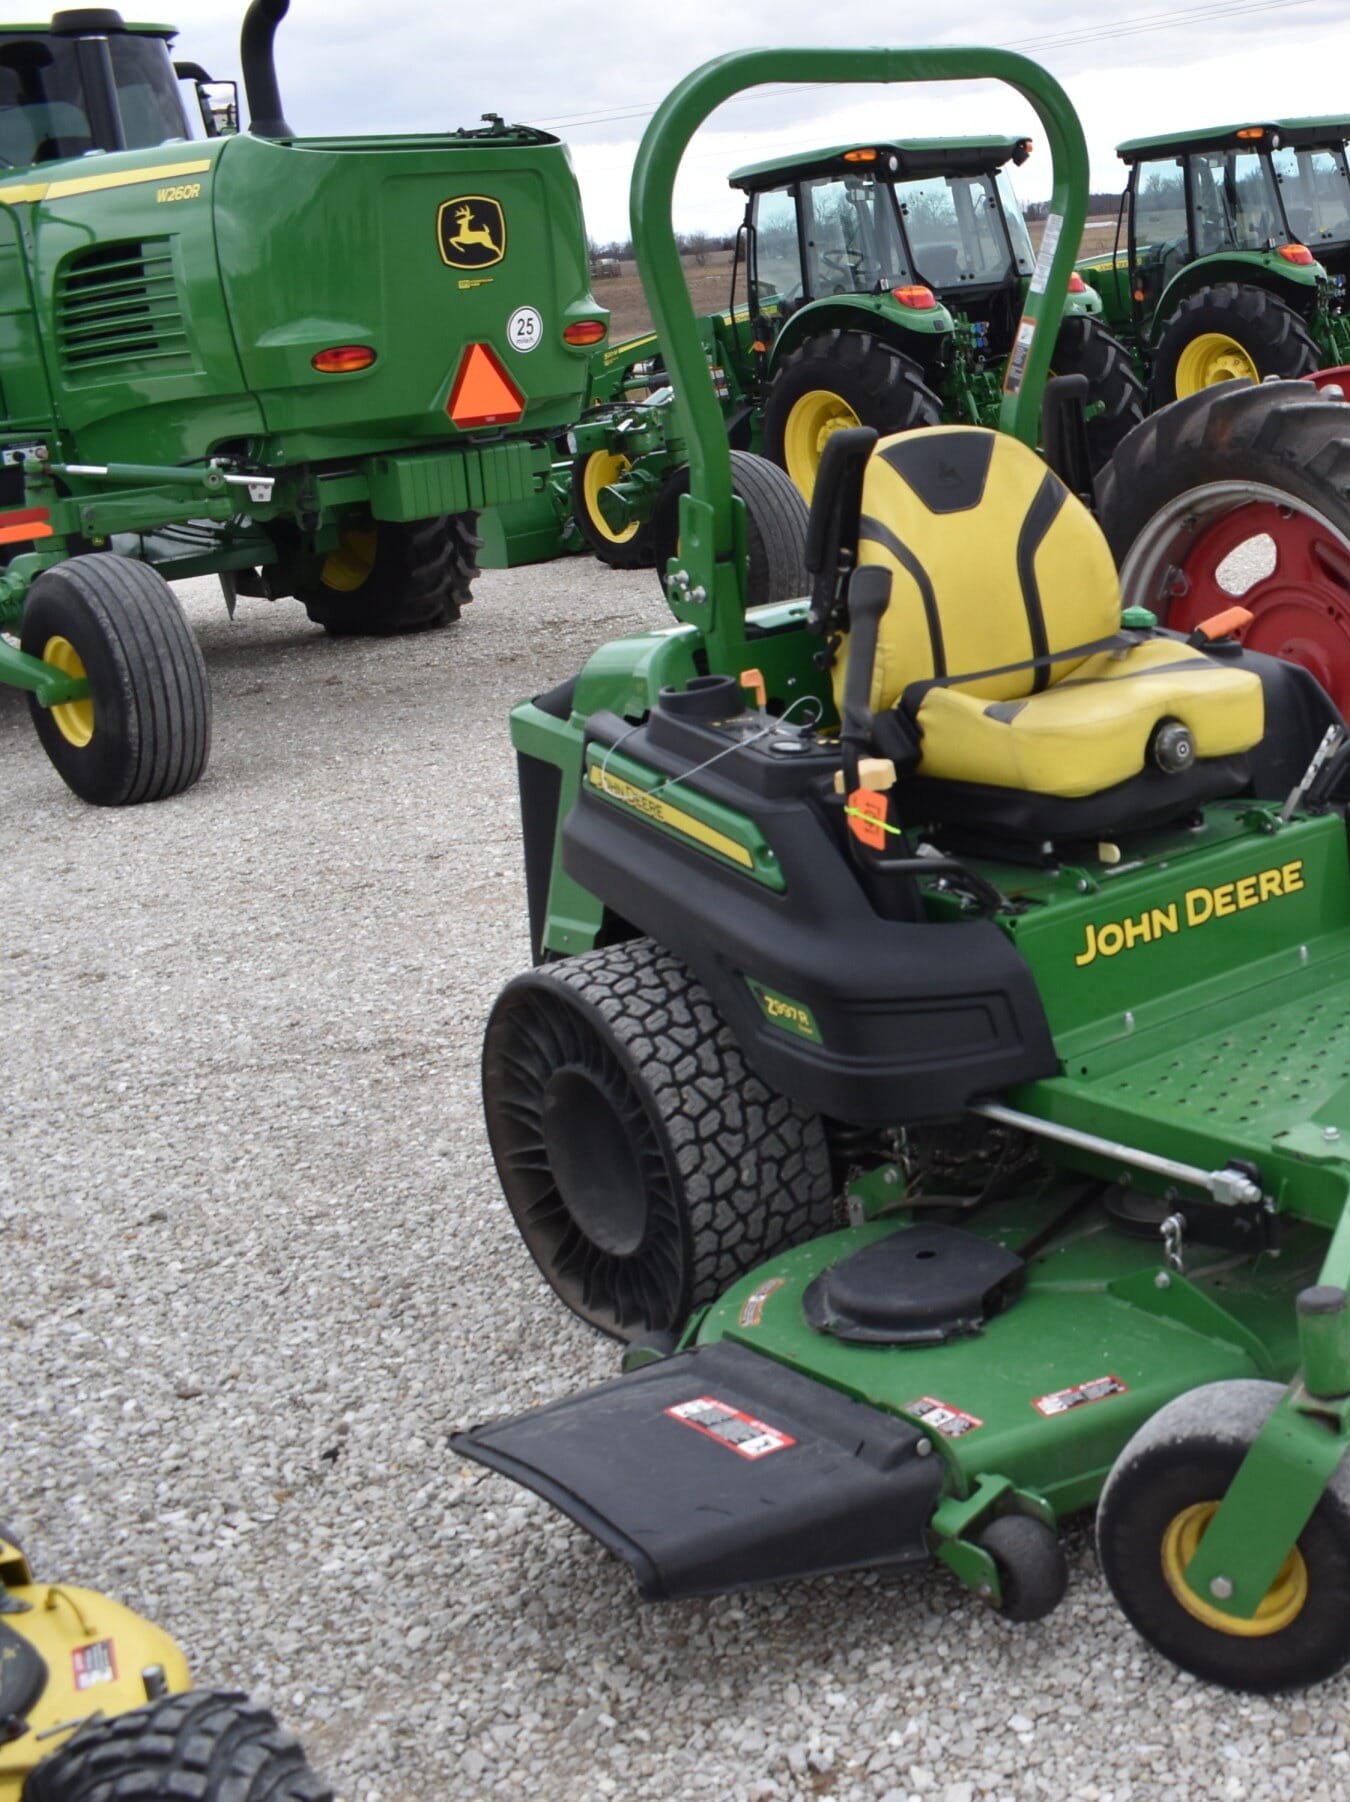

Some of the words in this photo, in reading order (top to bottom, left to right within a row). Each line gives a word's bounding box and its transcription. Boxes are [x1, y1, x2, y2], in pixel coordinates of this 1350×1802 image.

[517, 317, 535, 336] 25
[1076, 903, 1179, 966] JOHN
[1185, 860, 1305, 928] DEERE
